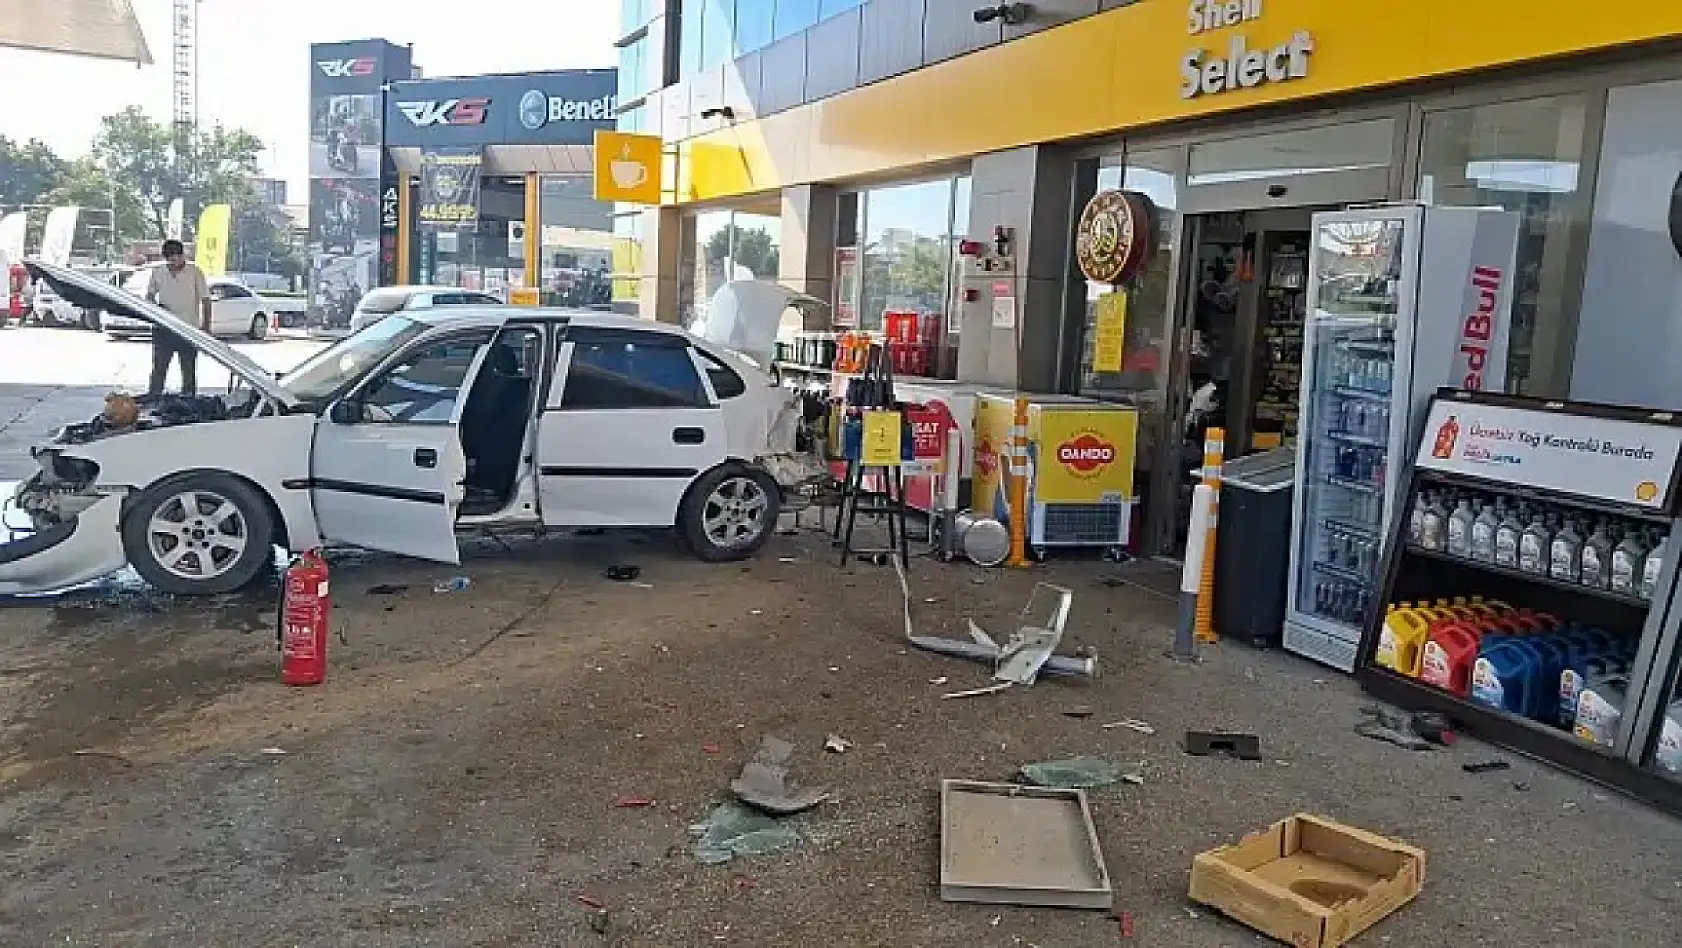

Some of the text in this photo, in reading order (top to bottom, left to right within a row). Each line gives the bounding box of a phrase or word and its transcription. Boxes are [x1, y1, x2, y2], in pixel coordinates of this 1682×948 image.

[1188, 0, 1262, 34] Shell
[317, 56, 378, 76] RKS
[1180, 30, 1315, 99] Select
[396, 97, 493, 127] RKS
[548, 94, 618, 121] Benell
[1460, 264, 1502, 390] ed Bull
[1603, 441, 1655, 460] Burada
